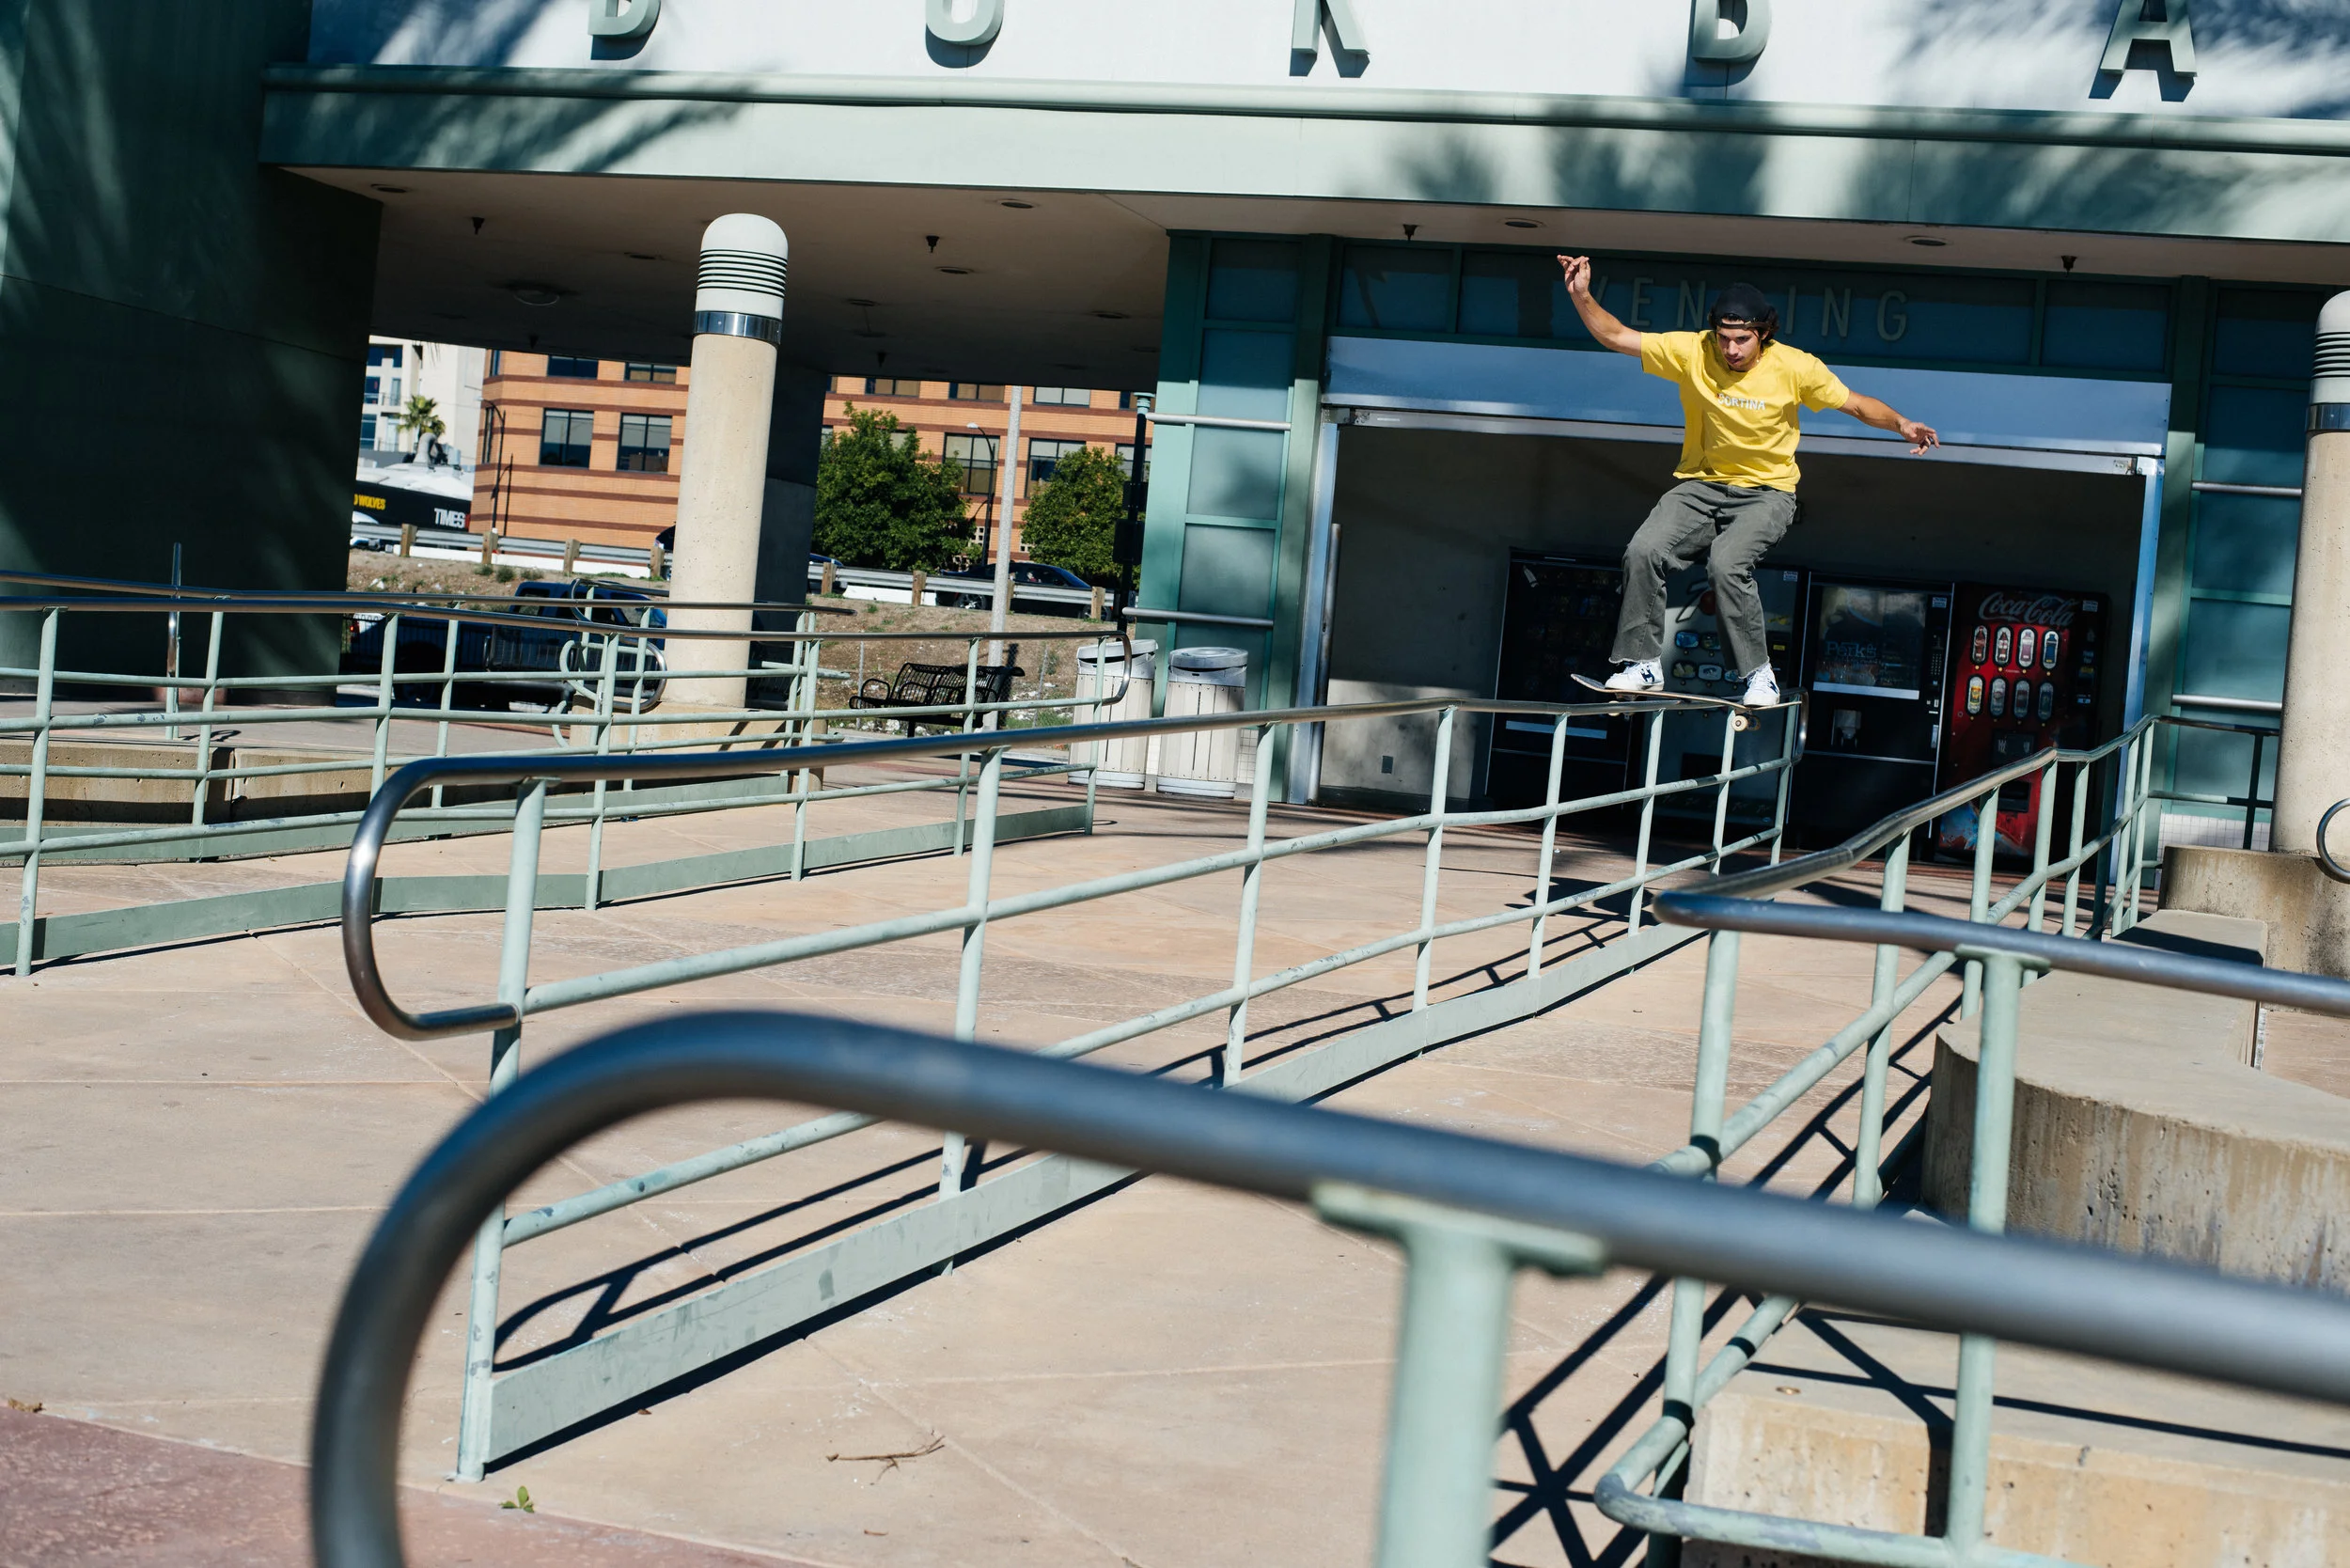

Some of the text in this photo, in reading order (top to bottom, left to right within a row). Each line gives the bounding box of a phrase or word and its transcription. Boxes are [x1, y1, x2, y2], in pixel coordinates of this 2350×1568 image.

[1595, 274, 1908, 341] ENING
[1717, 392, 1766, 411] CORTINA
[433, 507, 466, 529] TIMES
